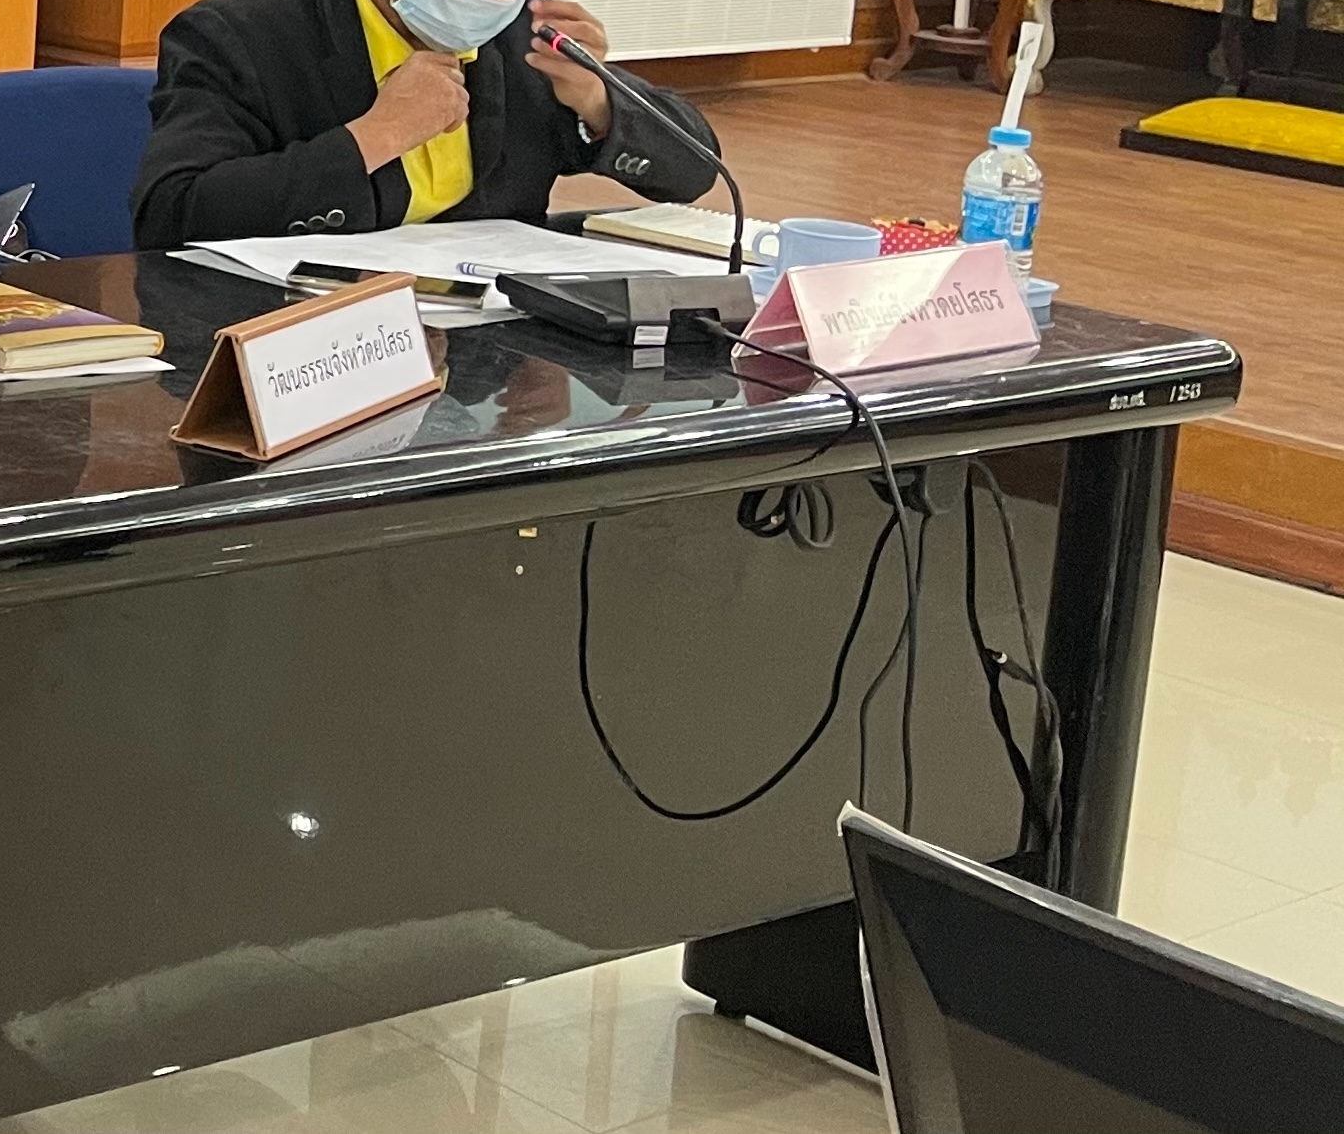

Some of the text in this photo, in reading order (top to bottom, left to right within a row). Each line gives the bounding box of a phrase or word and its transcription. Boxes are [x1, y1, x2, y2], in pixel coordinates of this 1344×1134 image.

[267, 323, 414, 398] วัฒนธรรมจังหวัดยโสธร
